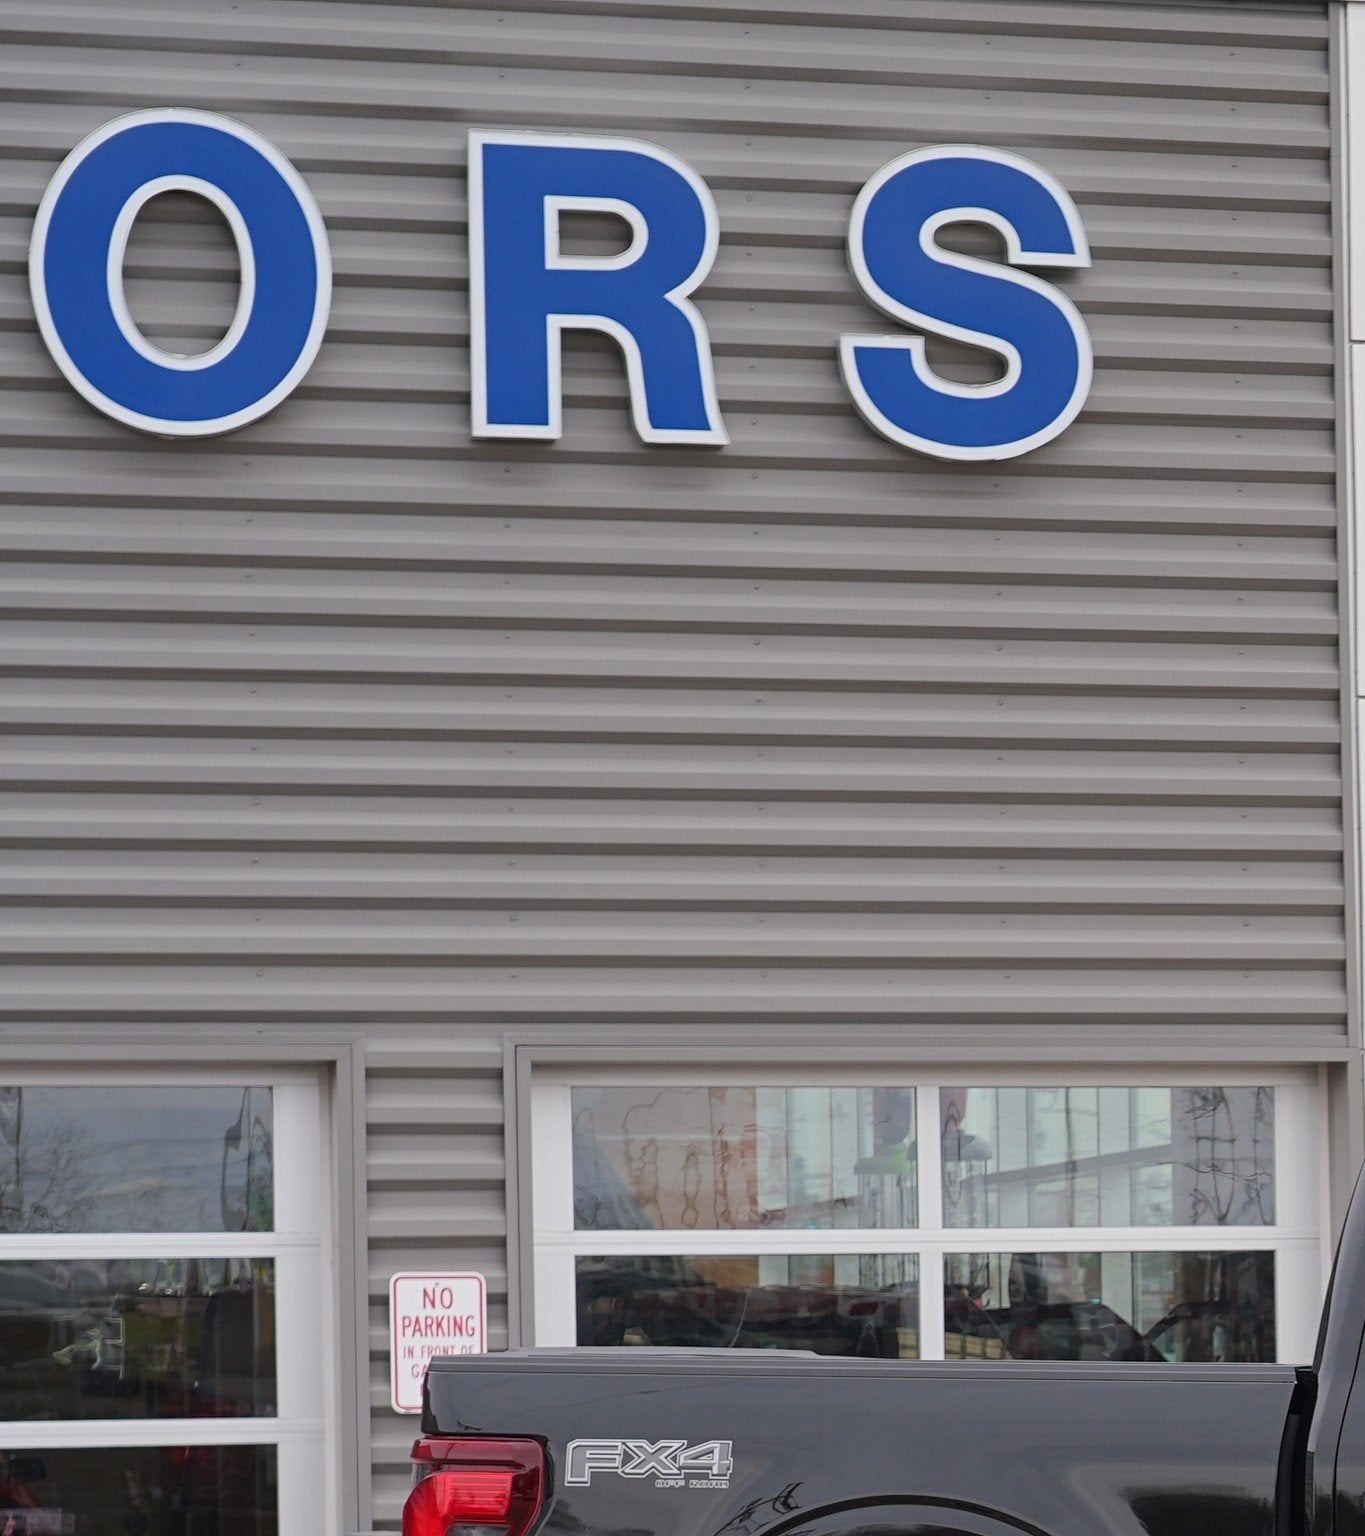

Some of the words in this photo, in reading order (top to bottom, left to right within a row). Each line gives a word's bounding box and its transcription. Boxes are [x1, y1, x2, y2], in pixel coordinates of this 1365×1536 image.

[422, 1287, 454, 1310] NO
[402, 1315, 476, 1338] PARKING
[403, 1345, 414, 1359] IN
[421, 1345, 455, 1358] FRONT
[565, 1439, 734, 1486] FX4
[655, 1479, 686, 1489] OFF
